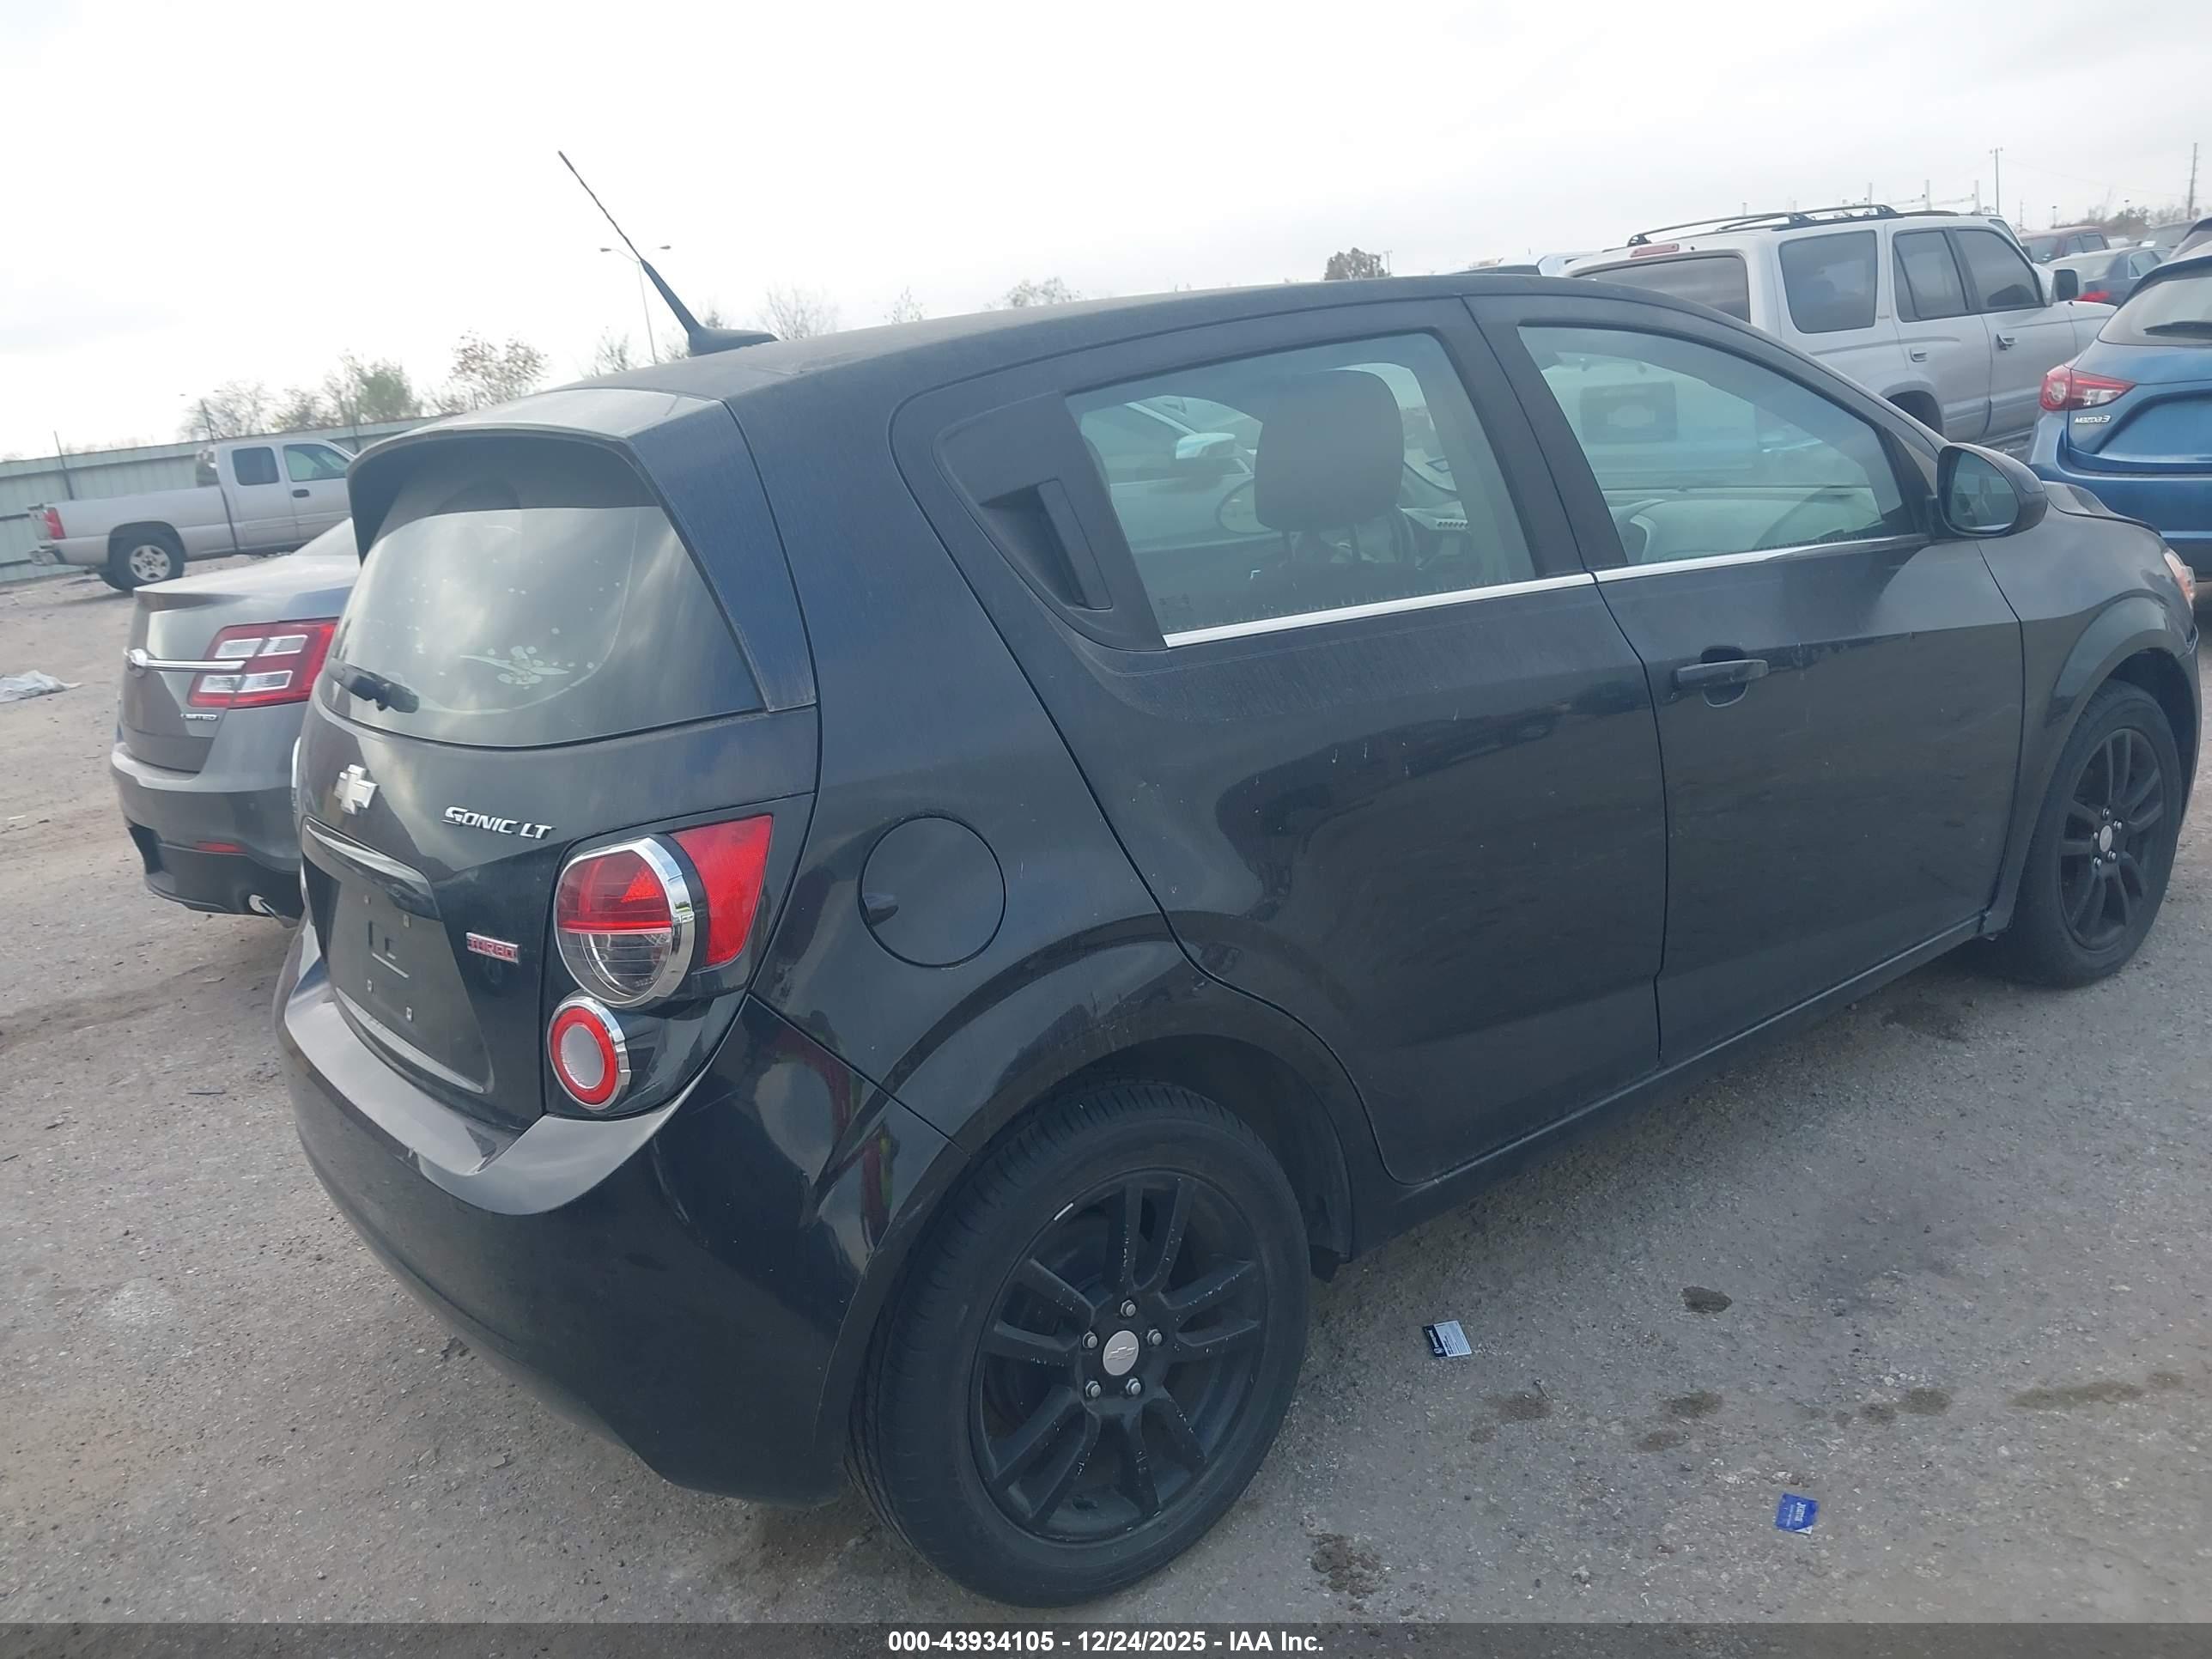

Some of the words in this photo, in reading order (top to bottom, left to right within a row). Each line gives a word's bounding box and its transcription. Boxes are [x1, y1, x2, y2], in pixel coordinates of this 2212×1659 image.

[441, 806, 519, 835] SONIC
[520, 823, 554, 839] LT
[467, 937, 517, 960] TURBO
